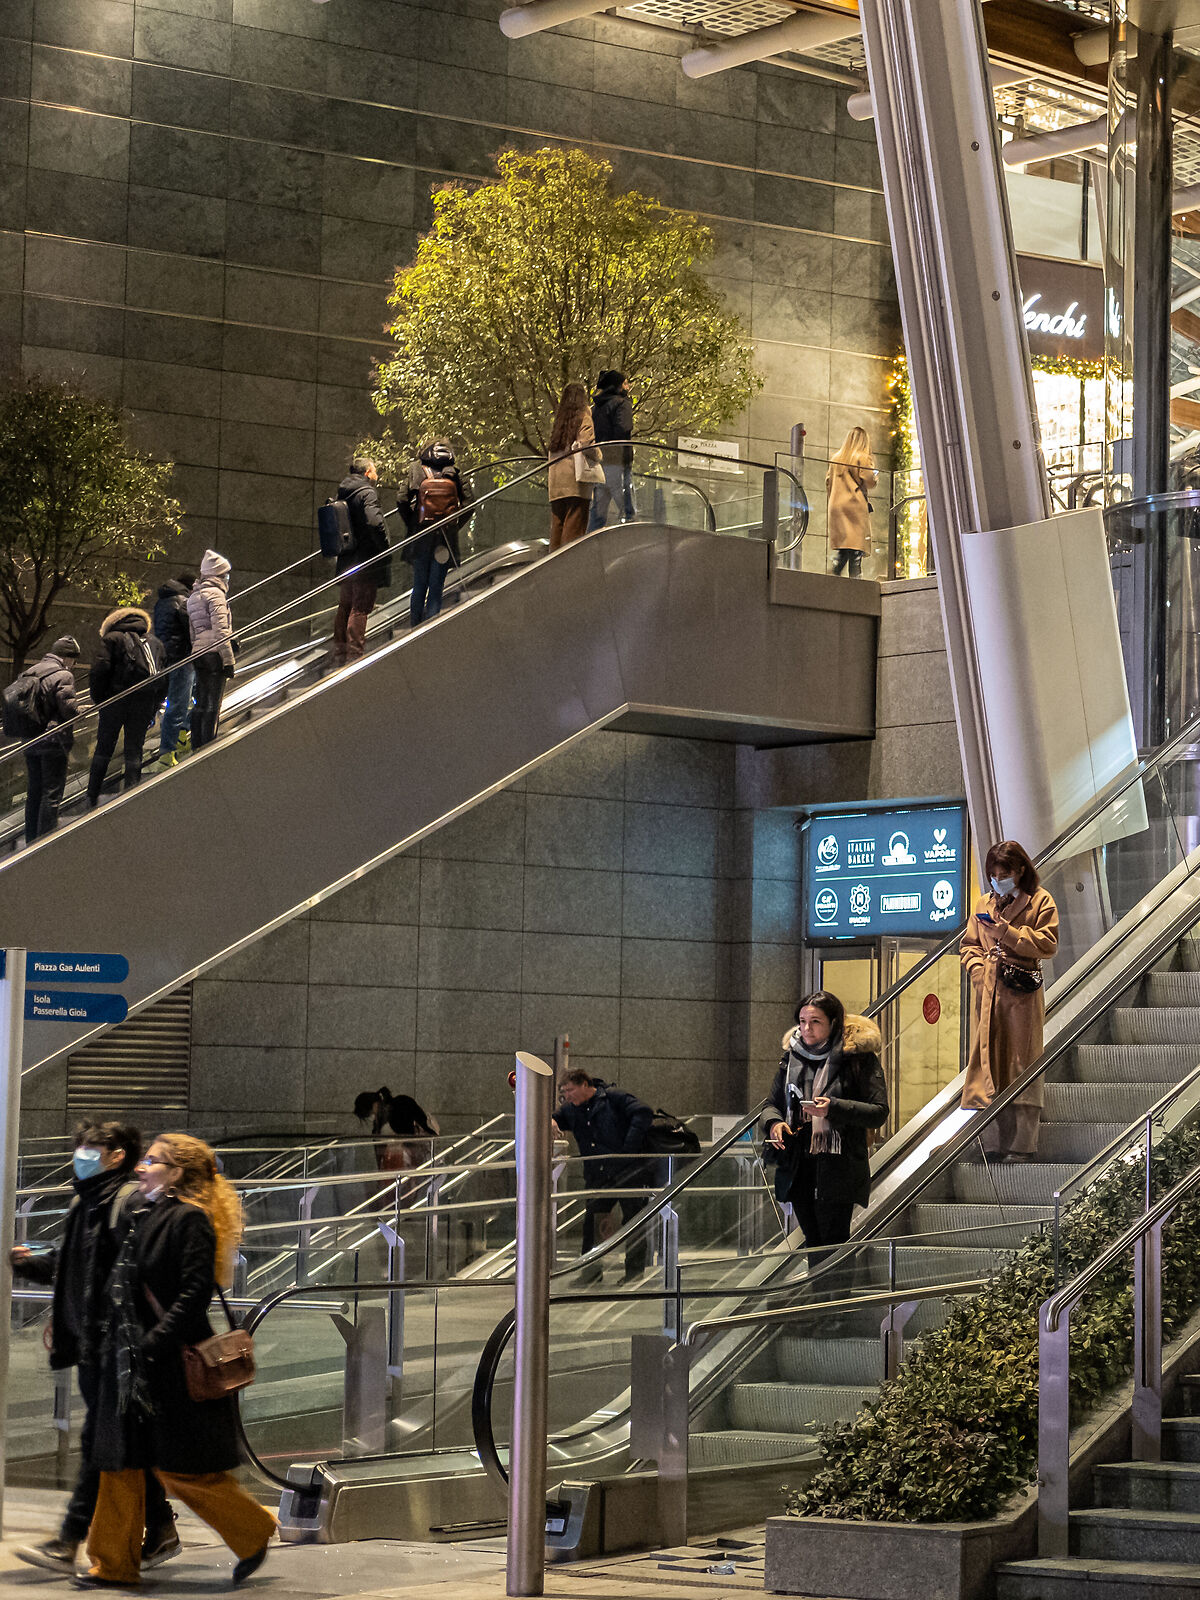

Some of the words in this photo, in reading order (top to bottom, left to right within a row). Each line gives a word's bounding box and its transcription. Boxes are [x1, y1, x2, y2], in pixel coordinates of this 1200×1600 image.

[848, 842, 876, 853] ITALIAN
[848, 853, 875, 865] BAKERY
[34, 962, 58, 972] Piazza
[59, 963, 73, 972] Gae
[74, 963, 101, 973] Aulenti
[33, 995, 51, 1004] Isola
[33, 1006, 68, 1017] Passerella
[69, 1008, 87, 1017] Gioia
